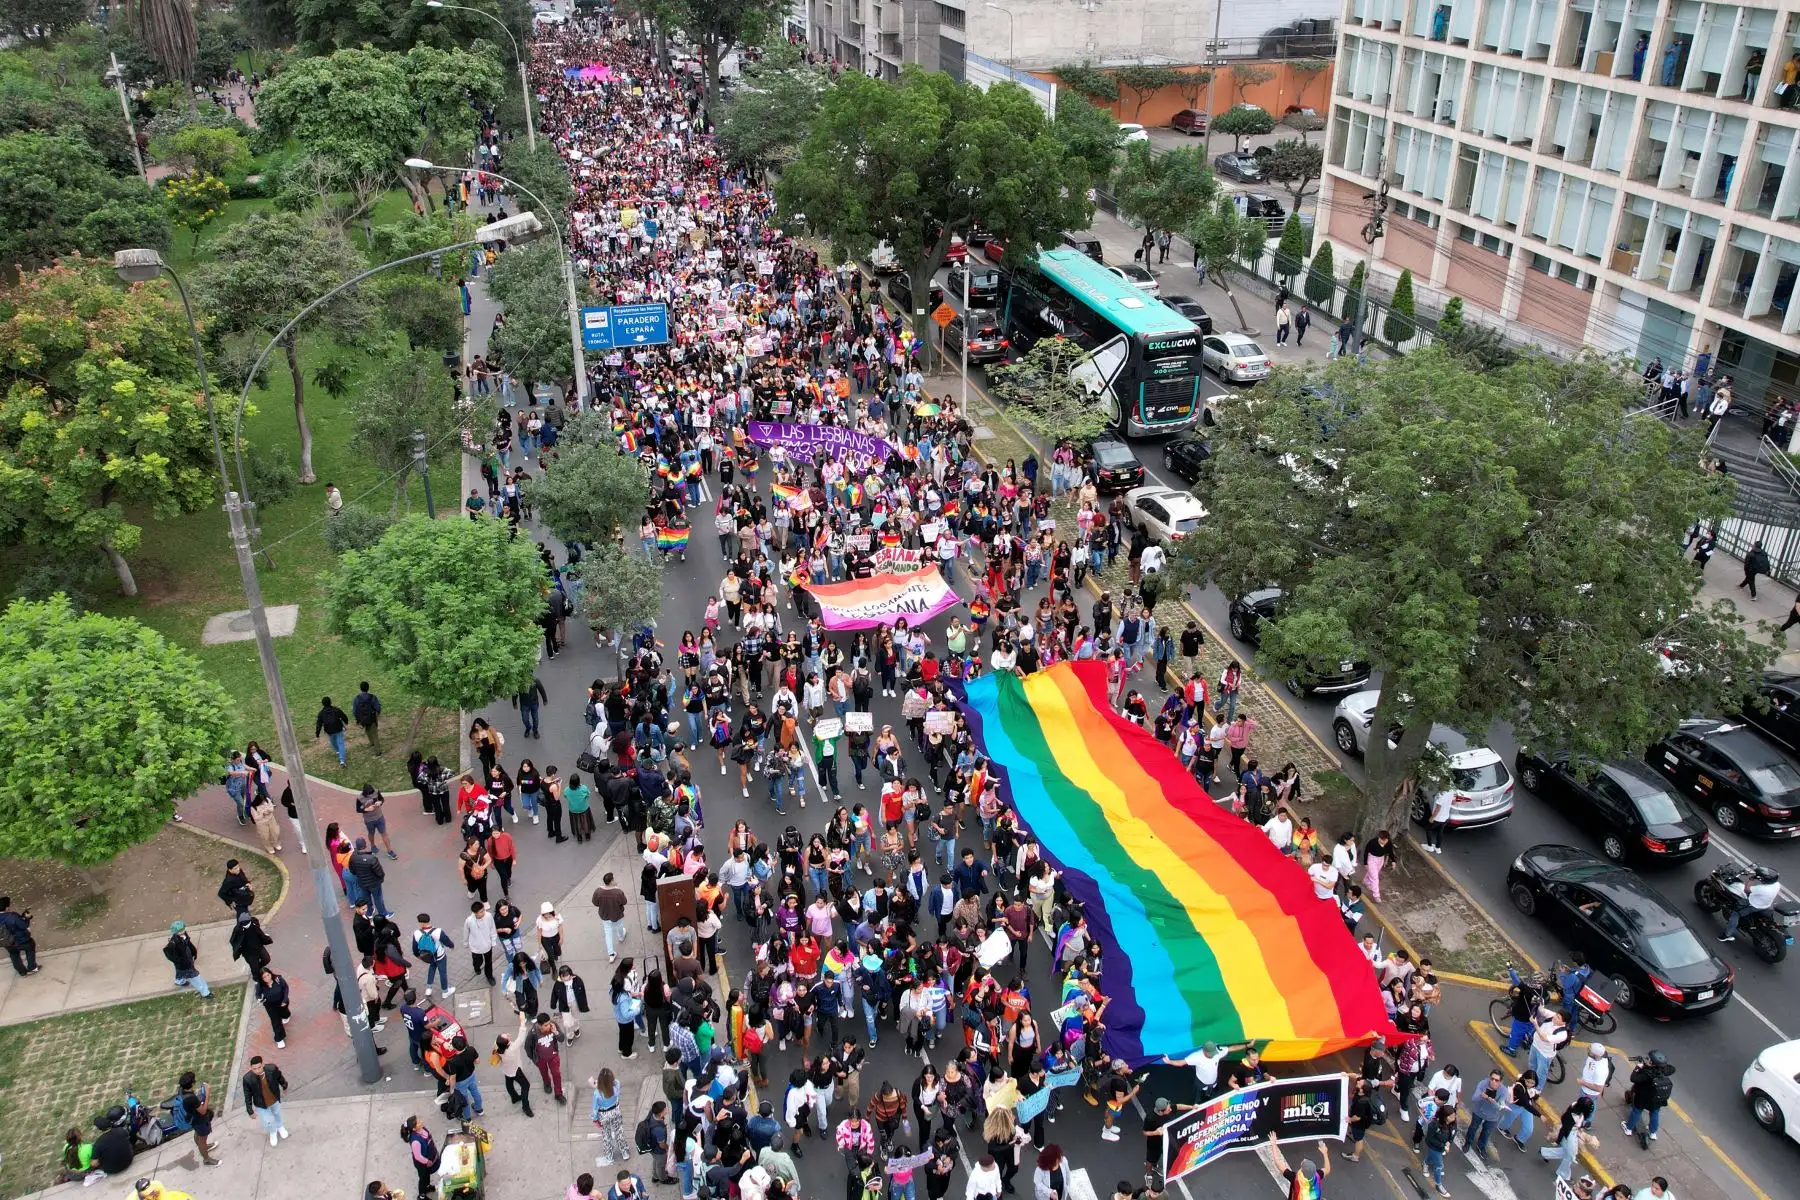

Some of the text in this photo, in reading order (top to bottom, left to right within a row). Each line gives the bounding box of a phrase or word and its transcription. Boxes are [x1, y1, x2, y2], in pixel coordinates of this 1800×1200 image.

[618, 316, 660, 326] PARADERO
[625, 326, 654, 334] ESPAÑA
[1050, 312, 1064, 332] CIVA
[1148, 338, 1196, 350] EXCLUCIVA
[782, 424, 876, 454] LAS LESBIANAS
[1206, 1100, 1260, 1124] RESISTIENDO
[1262, 1097, 1270, 1106] Y
[1187, 1112, 1258, 1144] DEFENDIENDO LA
[1194, 1126, 1250, 1150] DEMOCRACIA.
[1558, 1180, 1572, 1200] NO
